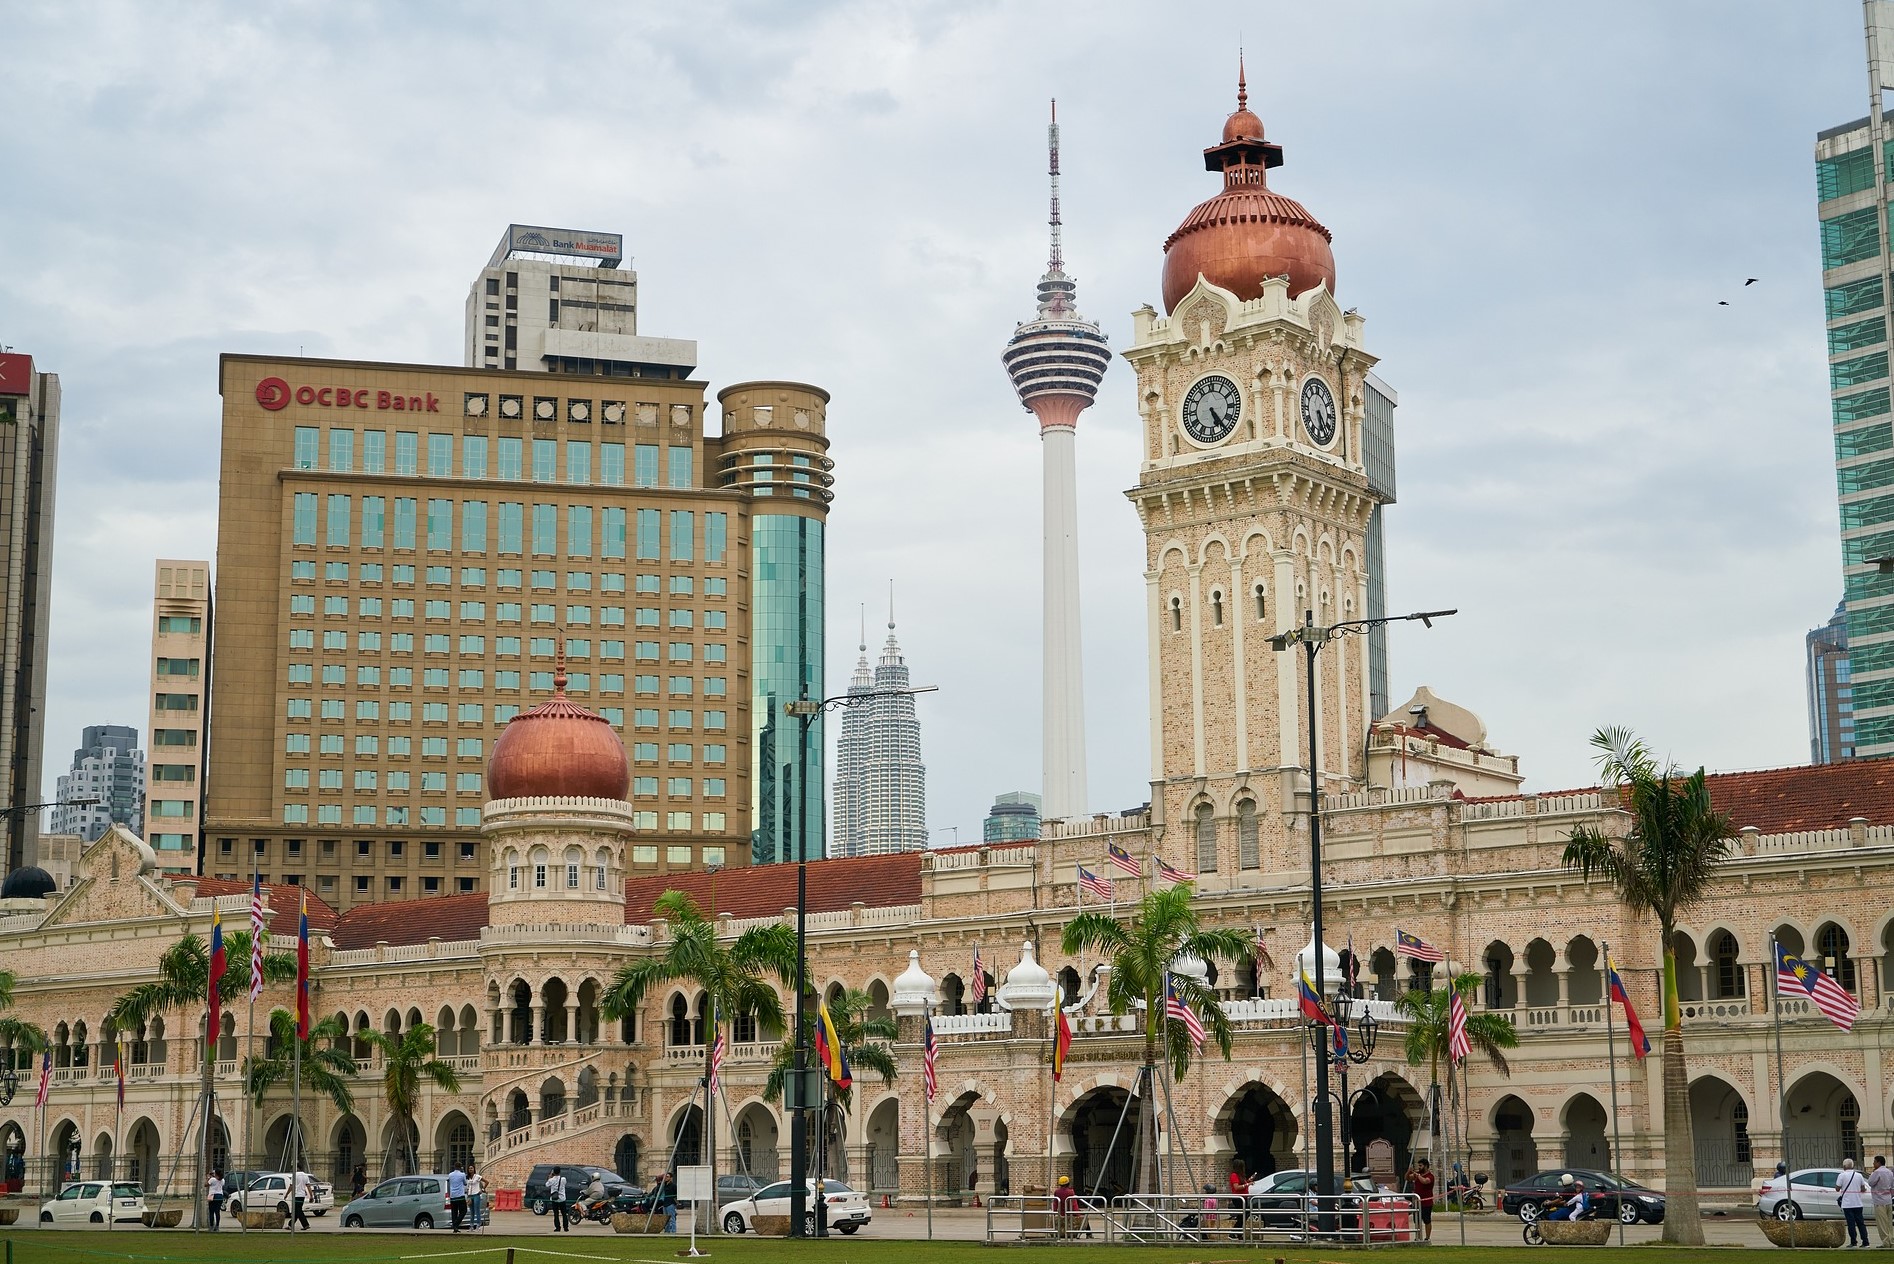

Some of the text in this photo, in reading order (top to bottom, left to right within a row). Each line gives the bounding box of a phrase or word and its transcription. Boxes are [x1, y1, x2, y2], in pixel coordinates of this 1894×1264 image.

[553, 240, 575, 250] Bank
[575, 242, 617, 253] Muamalat
[296, 386, 439, 413] OCBC Bank
